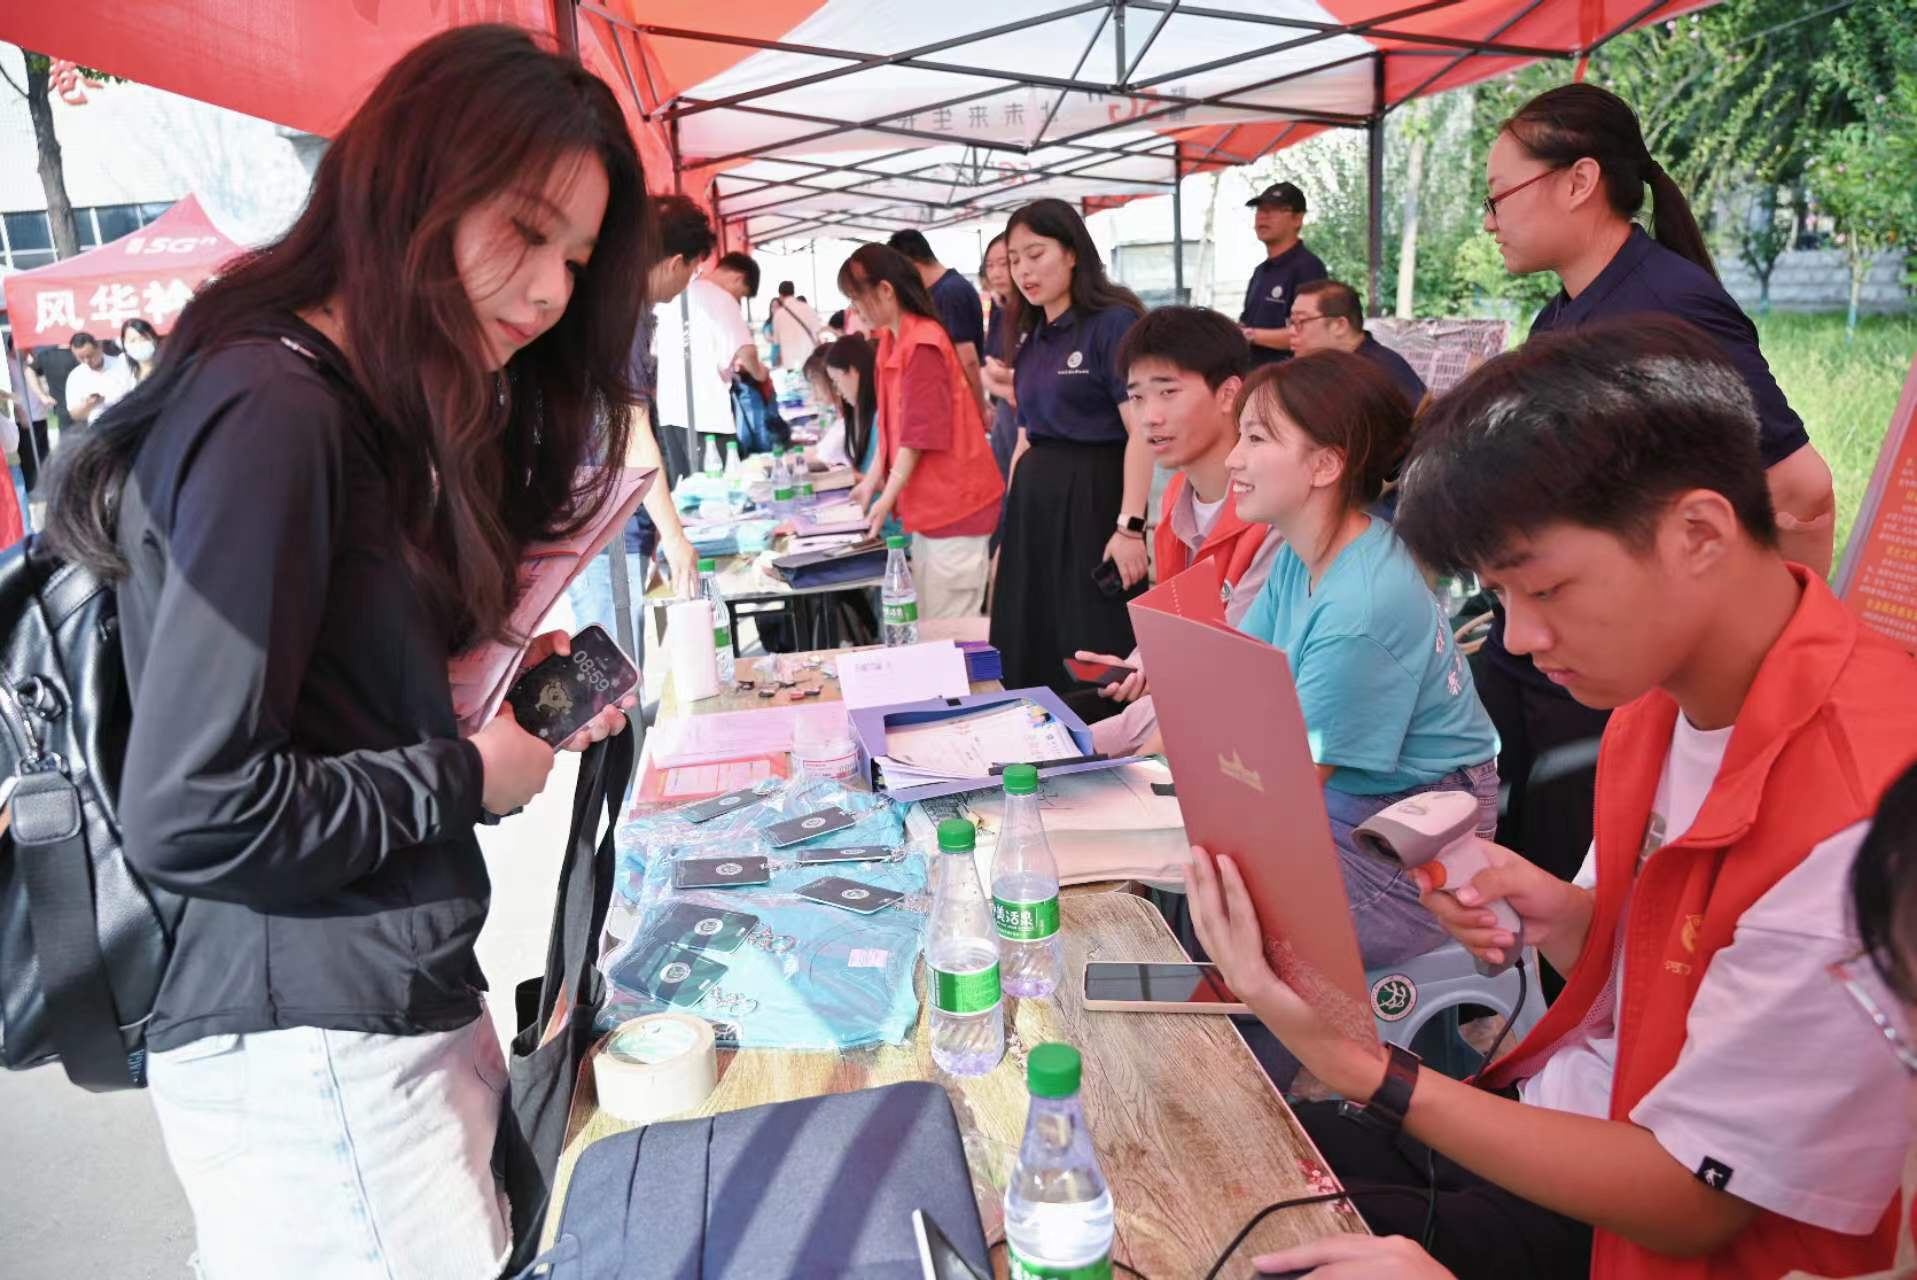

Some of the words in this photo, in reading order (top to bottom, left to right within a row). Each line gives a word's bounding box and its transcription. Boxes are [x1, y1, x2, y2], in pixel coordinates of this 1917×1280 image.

[572, 650, 610, 692] 08:59
[992, 903, 1034, 930] 美活泉
